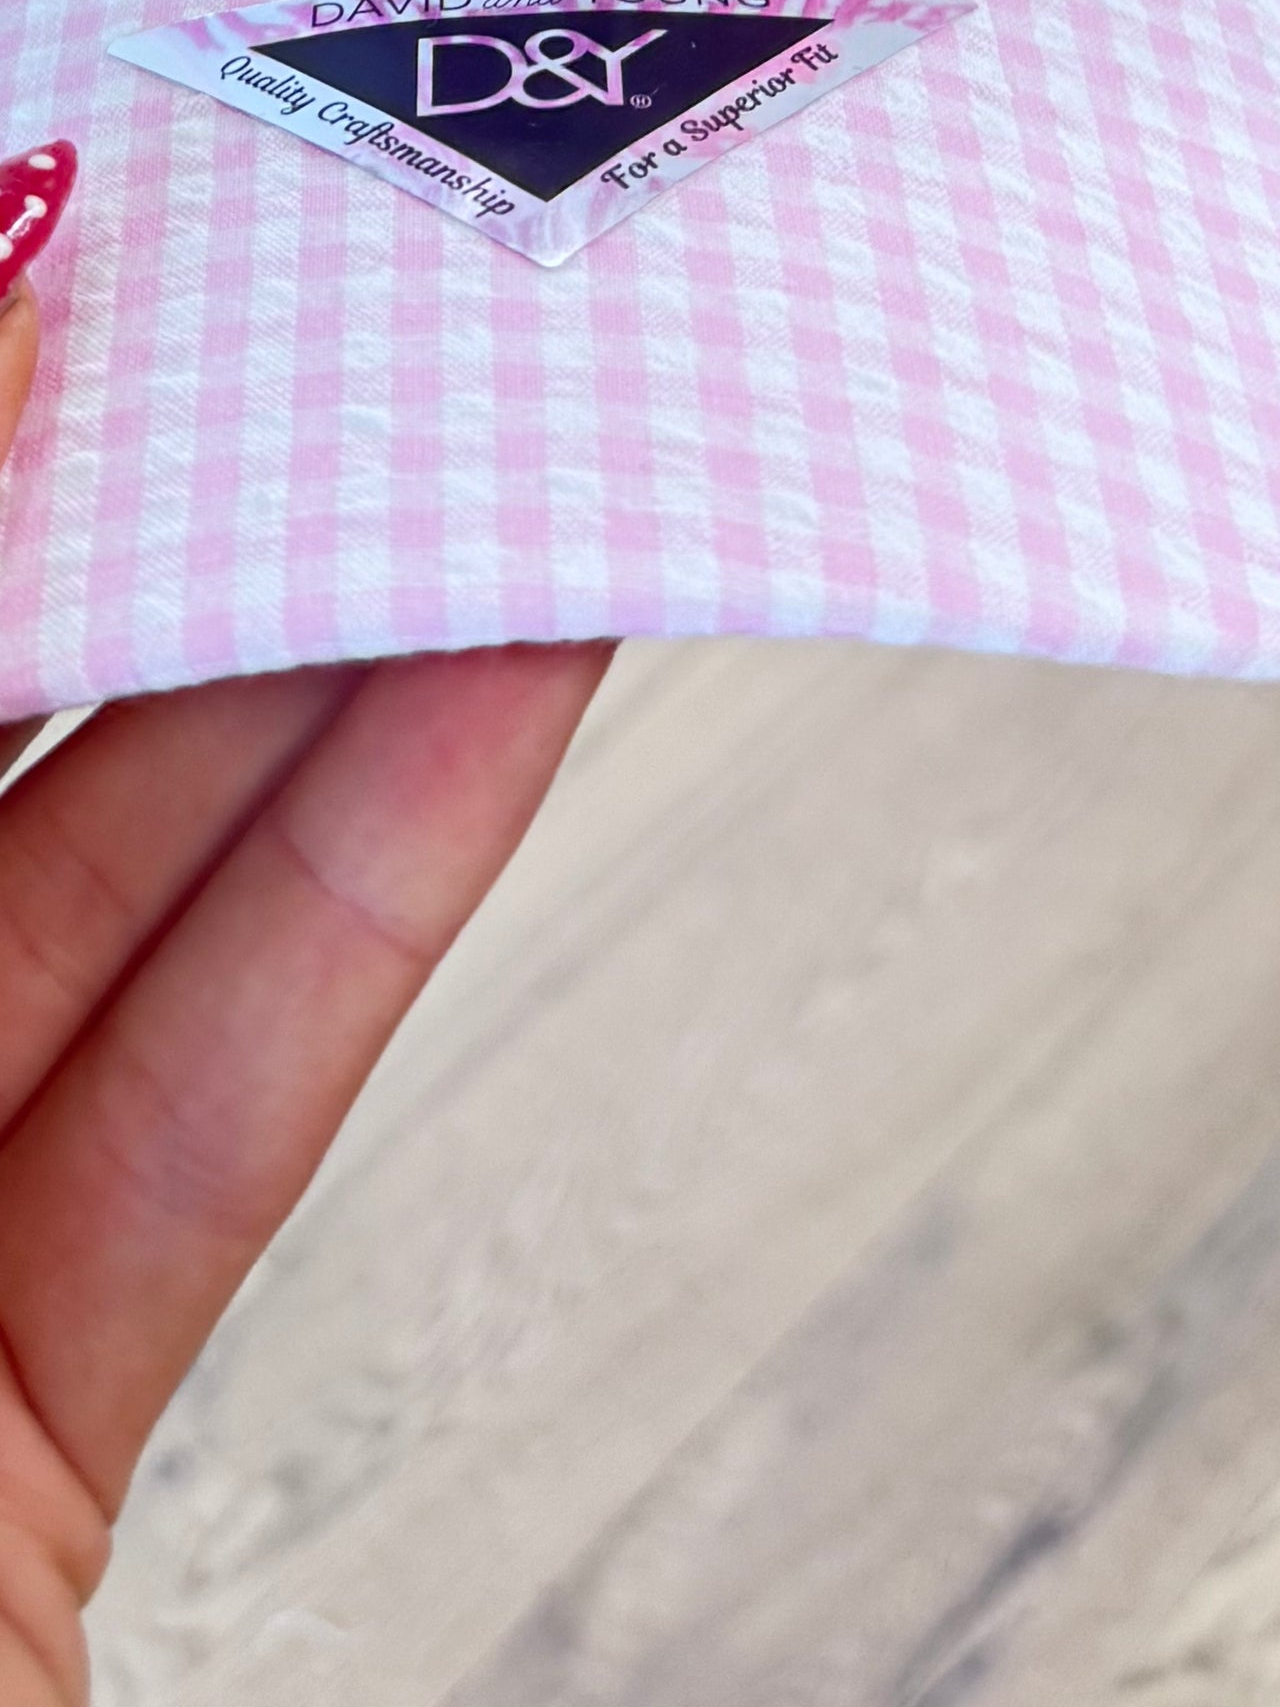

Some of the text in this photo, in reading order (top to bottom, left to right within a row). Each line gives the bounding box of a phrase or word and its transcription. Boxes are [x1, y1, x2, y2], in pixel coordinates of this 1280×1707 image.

[220, 55, 516, 219] Quality Craftsmanship
[600, 43, 839, 190] For a Superior Fit
